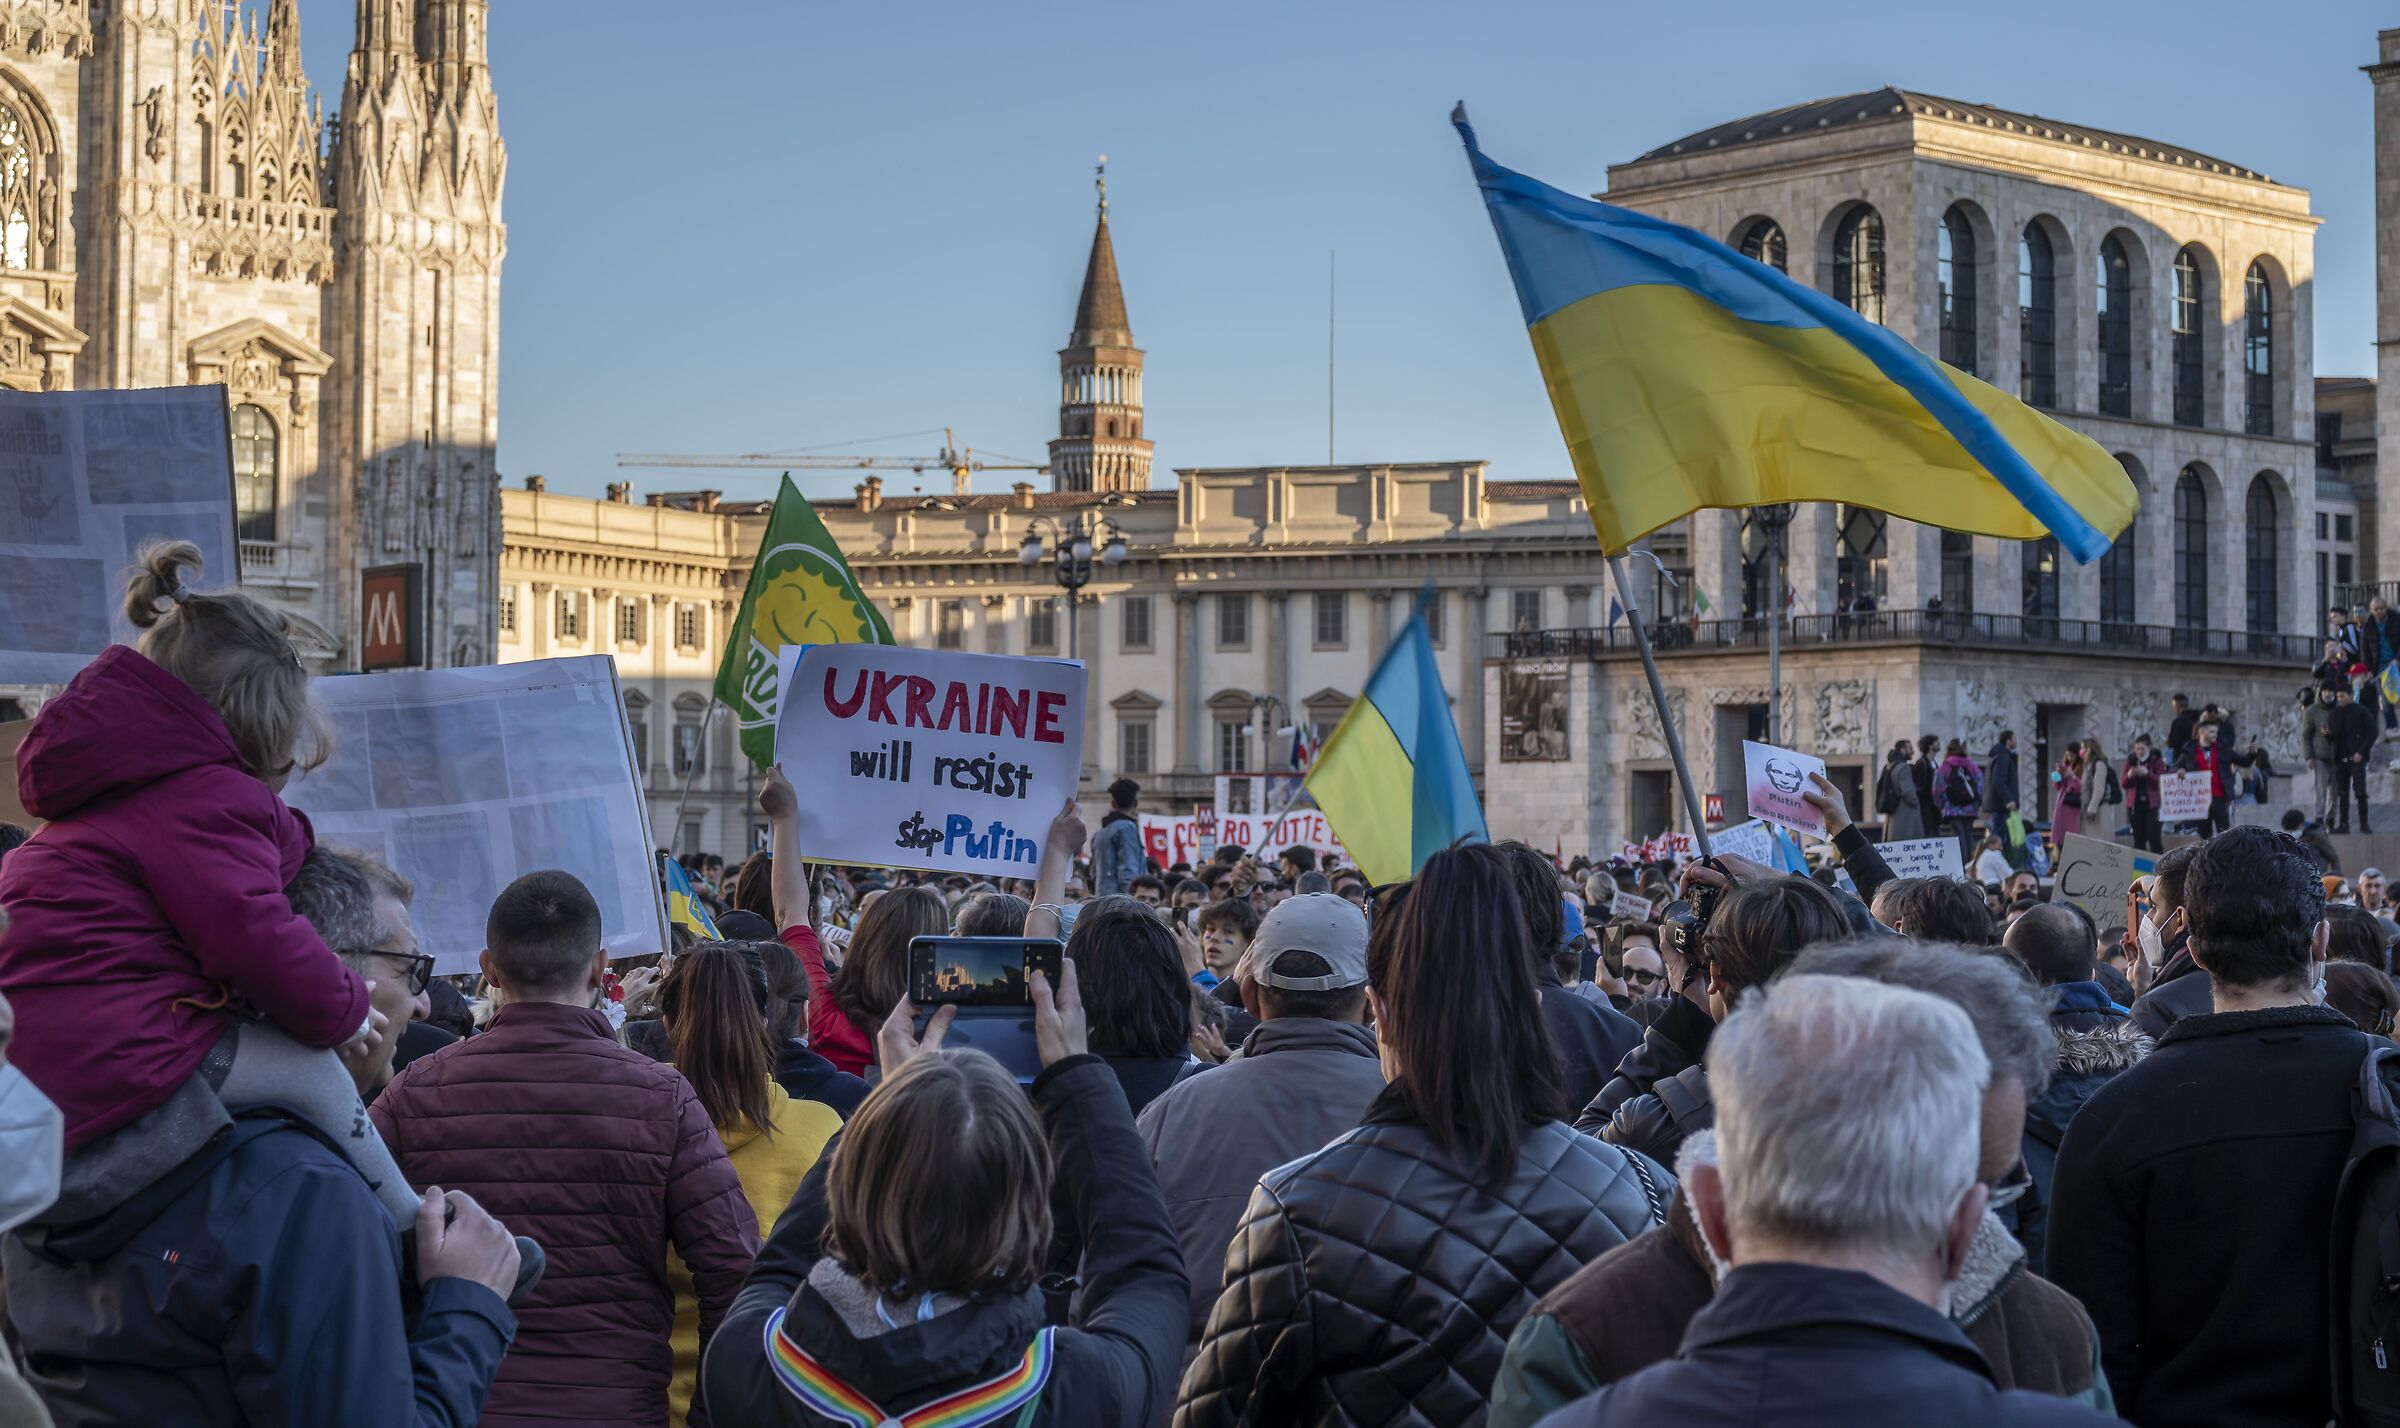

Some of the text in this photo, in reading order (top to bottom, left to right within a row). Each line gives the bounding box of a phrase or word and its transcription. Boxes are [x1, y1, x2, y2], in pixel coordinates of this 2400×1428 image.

[365, 591, 402, 647] M
[824, 667, 1067, 744] UKRAINE
[851, 740, 1033, 799] will resist
[1200, 809, 1214, 823] M
[1706, 803, 1723, 818] M
[1769, 793, 1801, 808] Putin
[1174, 819, 1250, 848] CORO
[1262, 815, 1323, 846] TUTTE
[1754, 805, 1817, 830] Assassino
[895, 811, 1037, 864] stop Putin
